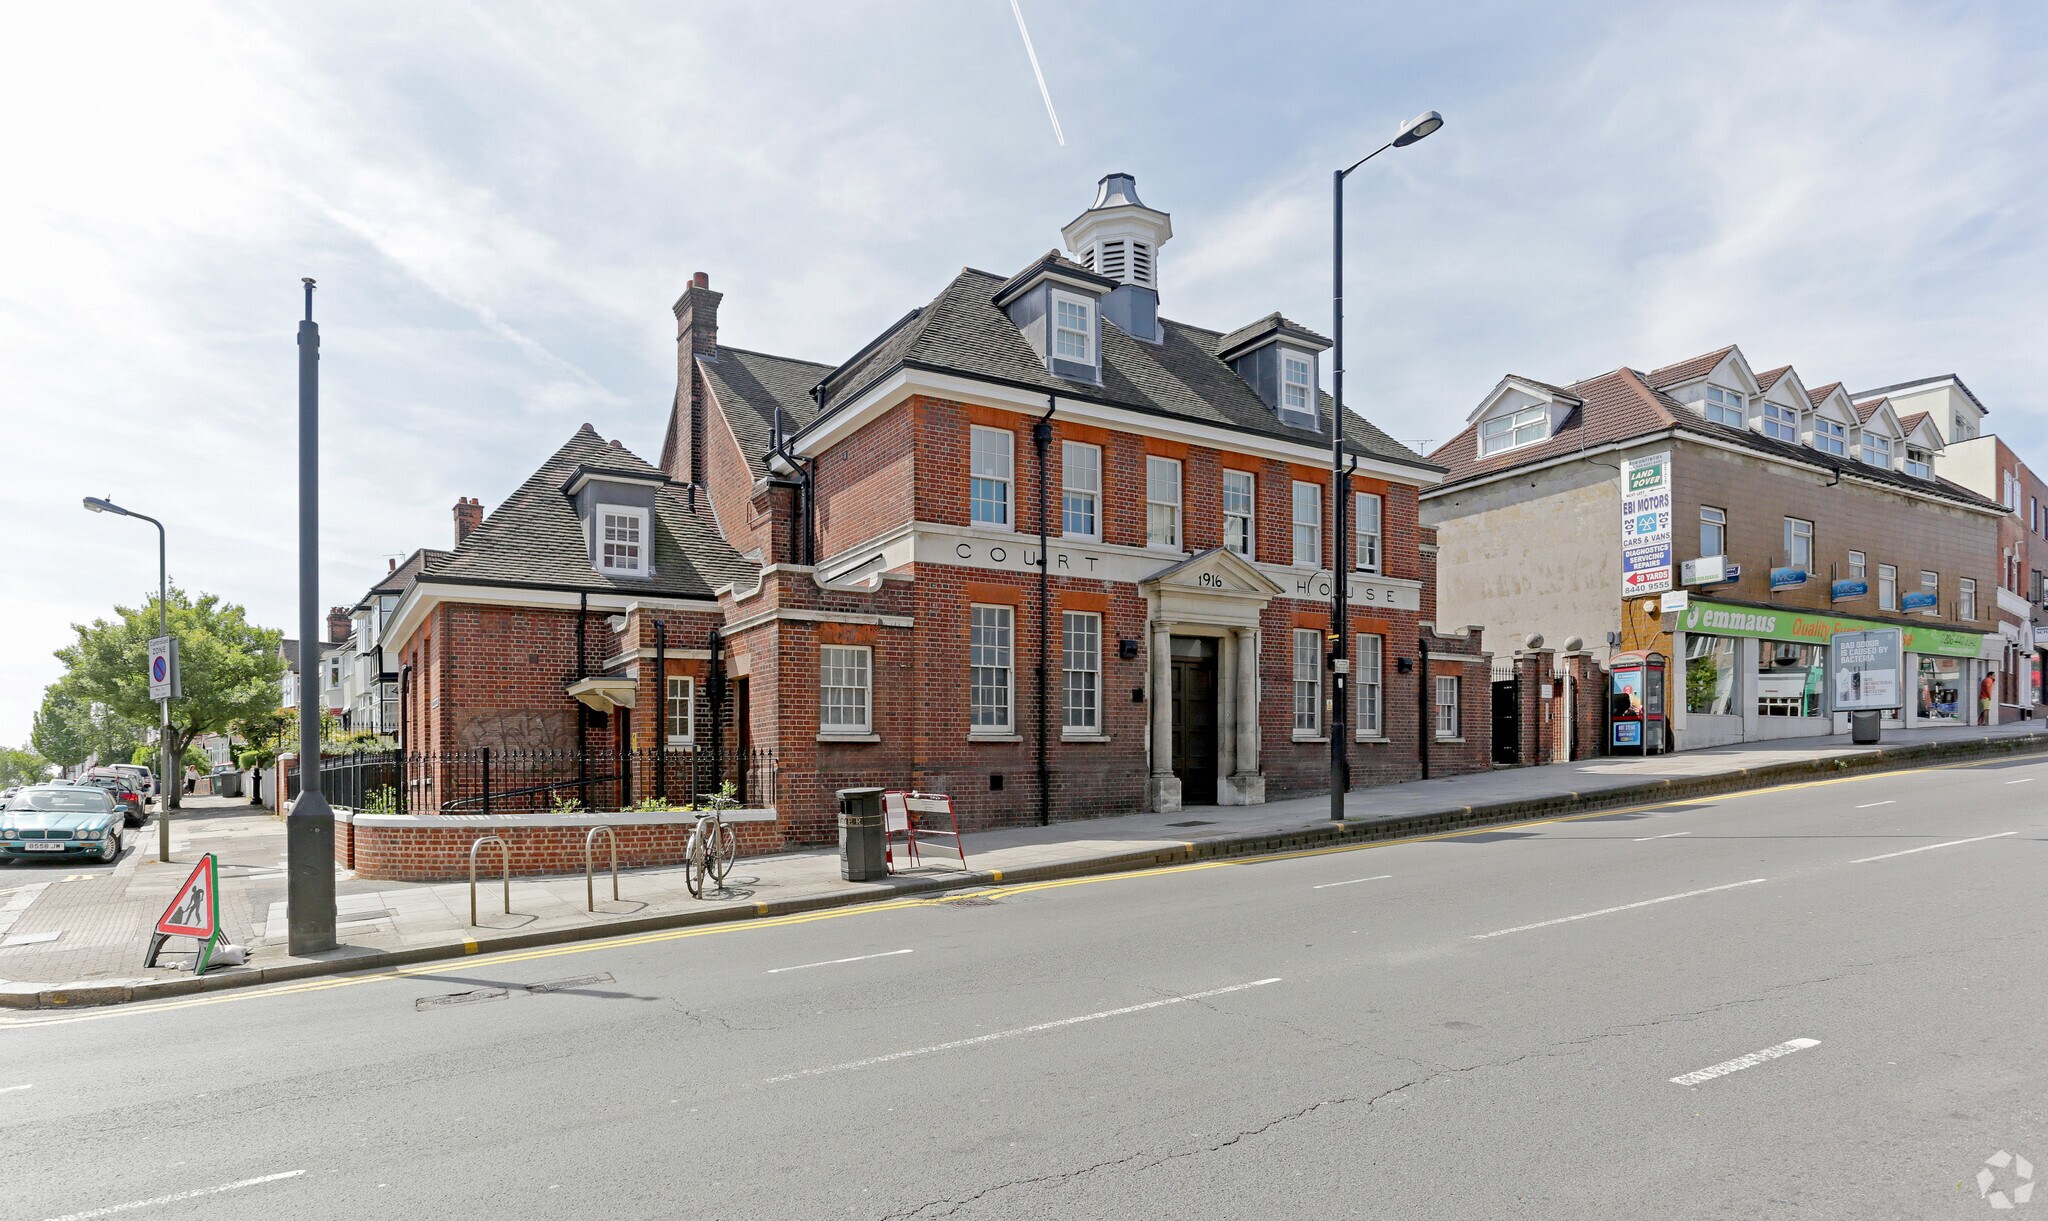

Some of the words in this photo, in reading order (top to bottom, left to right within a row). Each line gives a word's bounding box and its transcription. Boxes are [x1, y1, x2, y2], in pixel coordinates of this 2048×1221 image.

[1631, 469, 1654, 480] LAND
[1632, 475, 1661, 488] ROVER
[1623, 501, 1636, 515] EBI
[1637, 493, 1669, 512] MOTORS
[1659, 512, 1669, 528] MOT
[1625, 519, 1634, 535] MOT
[1624, 537, 1642, 547] CARS
[1651, 532, 1670, 541] VANS
[1625, 544, 1669, 557] DIAGNOSTICS
[956, 543, 1099, 572] COURT
[1630, 552, 1664, 564] SERVICING
[1633, 560, 1661, 570] REPAIRS
[1198, 572, 1222, 588] 1916
[1645, 571, 1668, 580] YARDS
[1625, 584, 1646, 594] 8440
[1648, 581, 1670, 591] 9555
[1703, 609, 1776, 633] emmaus
[1792, 617, 1831, 643] Quality
[152, 645, 166, 655] ZONE
[1841, 642, 1854, 650] BAD
[1856, 640, 1879, 648] ODOUR
[1841, 649, 1848, 657] IS
[1849, 647, 1877, 656] CAUSED
[1878, 646, 1888, 654] BY
[1841, 654, 1875, 664] BACTERIA
